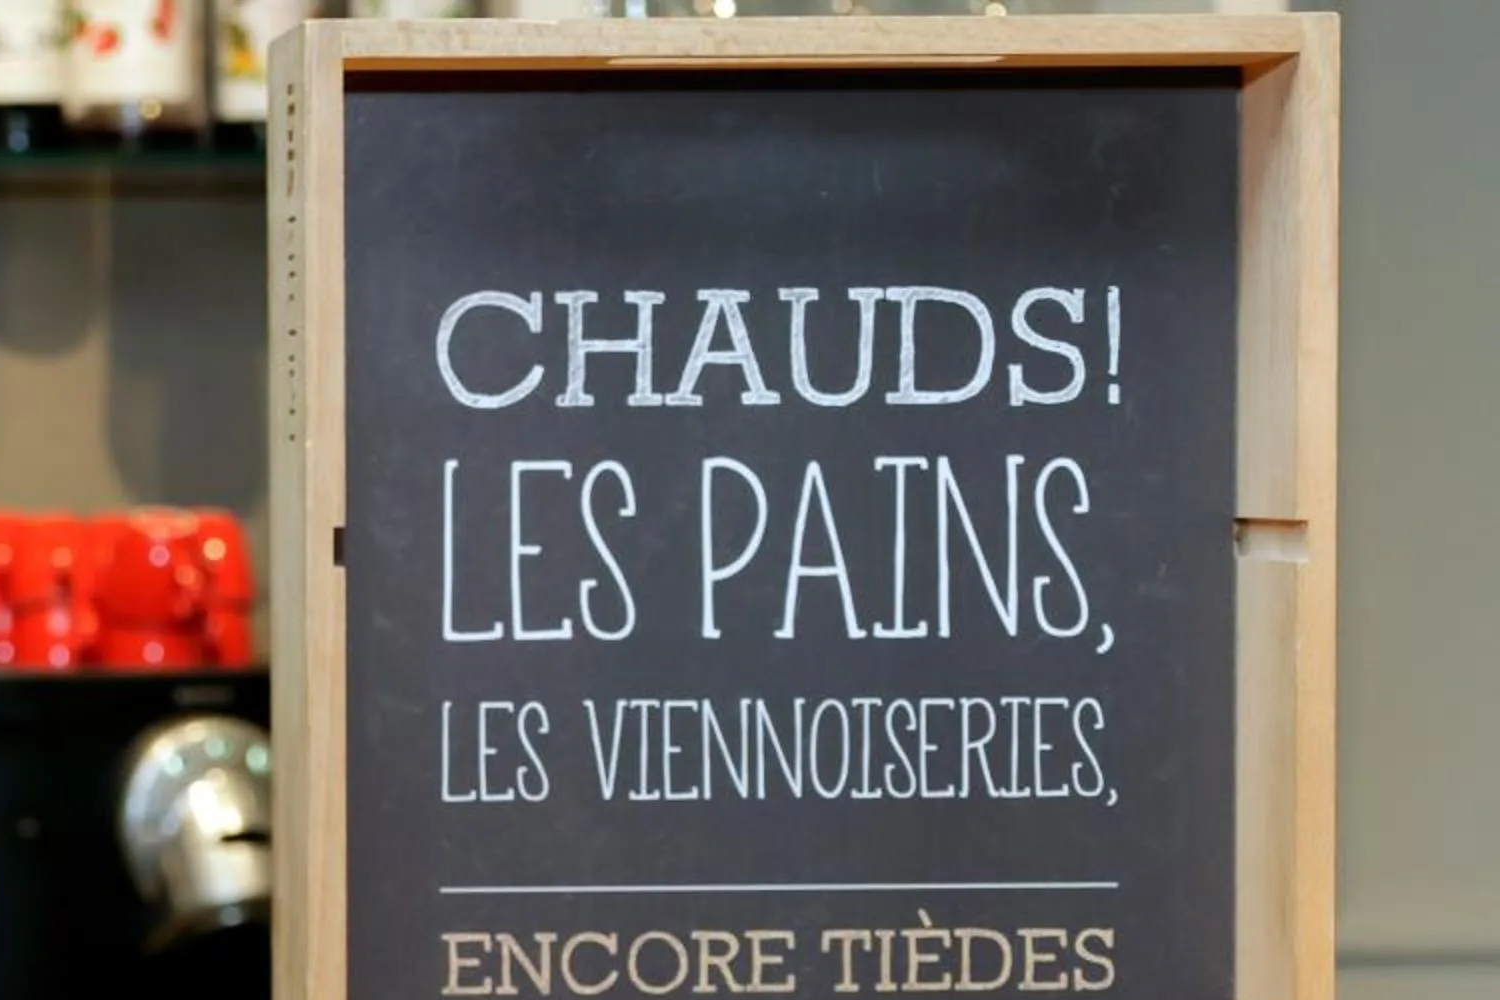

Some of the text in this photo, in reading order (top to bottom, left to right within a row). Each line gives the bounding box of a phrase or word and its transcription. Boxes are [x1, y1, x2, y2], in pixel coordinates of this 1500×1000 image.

[434, 285, 1121, 410] CHAUDS!
[441, 453, 1115, 655] LES PAINS,
[440, 695, 1119, 807] LES VIENNOISERIES,
[440, 908, 1115, 996] ENCORE TIÈDES
